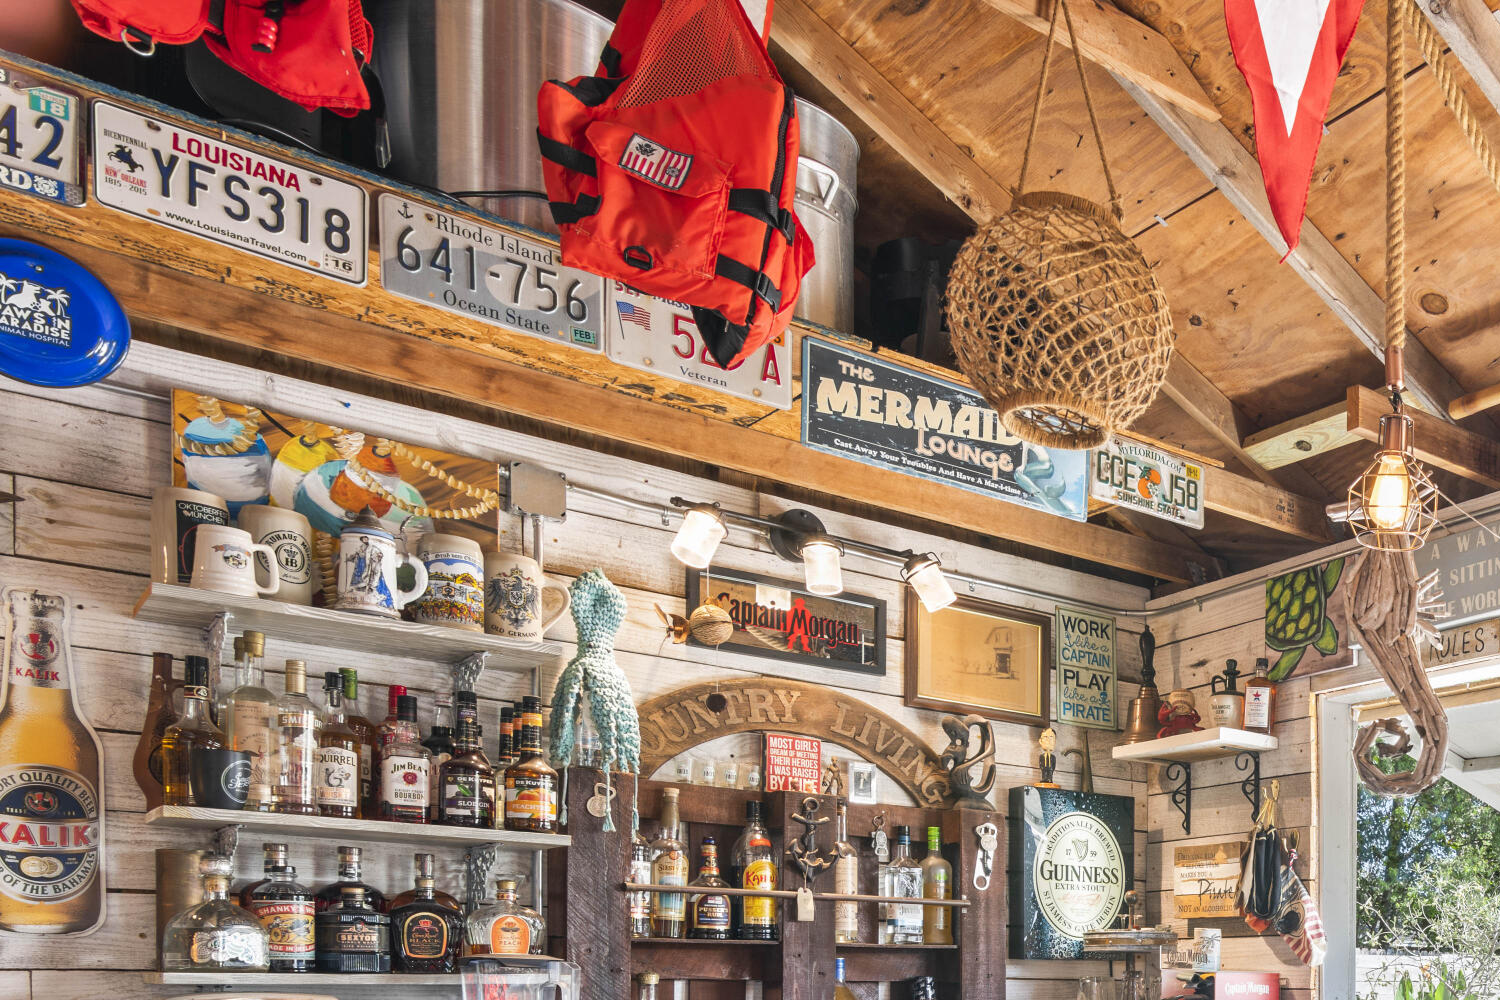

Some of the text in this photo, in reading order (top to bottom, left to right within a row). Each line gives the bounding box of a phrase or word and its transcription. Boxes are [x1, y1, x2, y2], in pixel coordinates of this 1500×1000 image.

[39, 99, 66, 117] 18
[103, 128, 149, 150] BICENTENNIAL
[172, 132, 302, 193] LOUISIANA
[104, 164, 148, 189] NEW ORLEANS
[104, 176, 148, 197] 1815 2015
[151, 148, 351, 255] YFS318
[165, 210, 308, 262] www.LouisianaTravel.com
[435, 212, 554, 267] Rhode Island
[331, 258, 354, 273] 16
[397, 225, 588, 323] 641-756
[443, 288, 551, 336] Ocean State
[28, 330, 71, 348] HOSPITAL
[573, 328, 592, 341] FEB
[679, 365, 728, 388] Veteran
[837, 360, 876, 382] THE
[834, 438, 853, 450] Cast
[854, 443, 878, 458] Away
[880, 451, 900, 463] Your
[900, 456, 938, 473] Troubles
[938, 465, 955, 478] And
[956, 471, 976, 483] Have
[915, 428, 1014, 481] LOUNGE
[1096, 450, 1198, 512] CCE J58
[1117, 491, 1182, 519] SUNSHINE STATE
[1430, 543, 1441, 562] A
[489, 624, 537, 638] OLD GERMANY
[789, 608, 860, 649] Morgan
[1061, 614, 1111, 641] WORK
[1072, 634, 1110, 653] like a
[1061, 647, 1111, 668] CAPTAIN
[15, 666, 61, 682] KALIK
[1063, 669, 1110, 691] PLAY
[1063, 686, 1089, 701] like
[1062, 701, 1111, 722] PIRATE
[769, 736, 818, 753] MOST GIRLS
[829, 700, 948, 808] LIVING
[391, 762, 428, 777] JIM BEAM
[770, 756, 818, 769] THEIR HEROES
[774, 765, 790, 776] WAS
[792, 767, 818, 779] RAISED
[19, 772, 95, 815] QUALITY BEER
[770, 775, 785, 791] BY
[394, 791, 426, 800] BOURBON
[1045, 820, 1116, 862] TRADITIONALLY BREWED
[3, 853, 96, 895] OF THE BAHAMAS
[1039, 859, 1120, 885] GUINNESS
[1055, 882, 1107, 893] EXTRA STOUT
[1073, 896, 1117, 934] GATE DUBLIN
[1178, 904, 1194, 914] NOT
[1202, 904, 1233, 913] ALCOHOLIC
[340, 934, 378, 943] SEXTON
[1225, 981, 1271, 997] Captain Morgan
